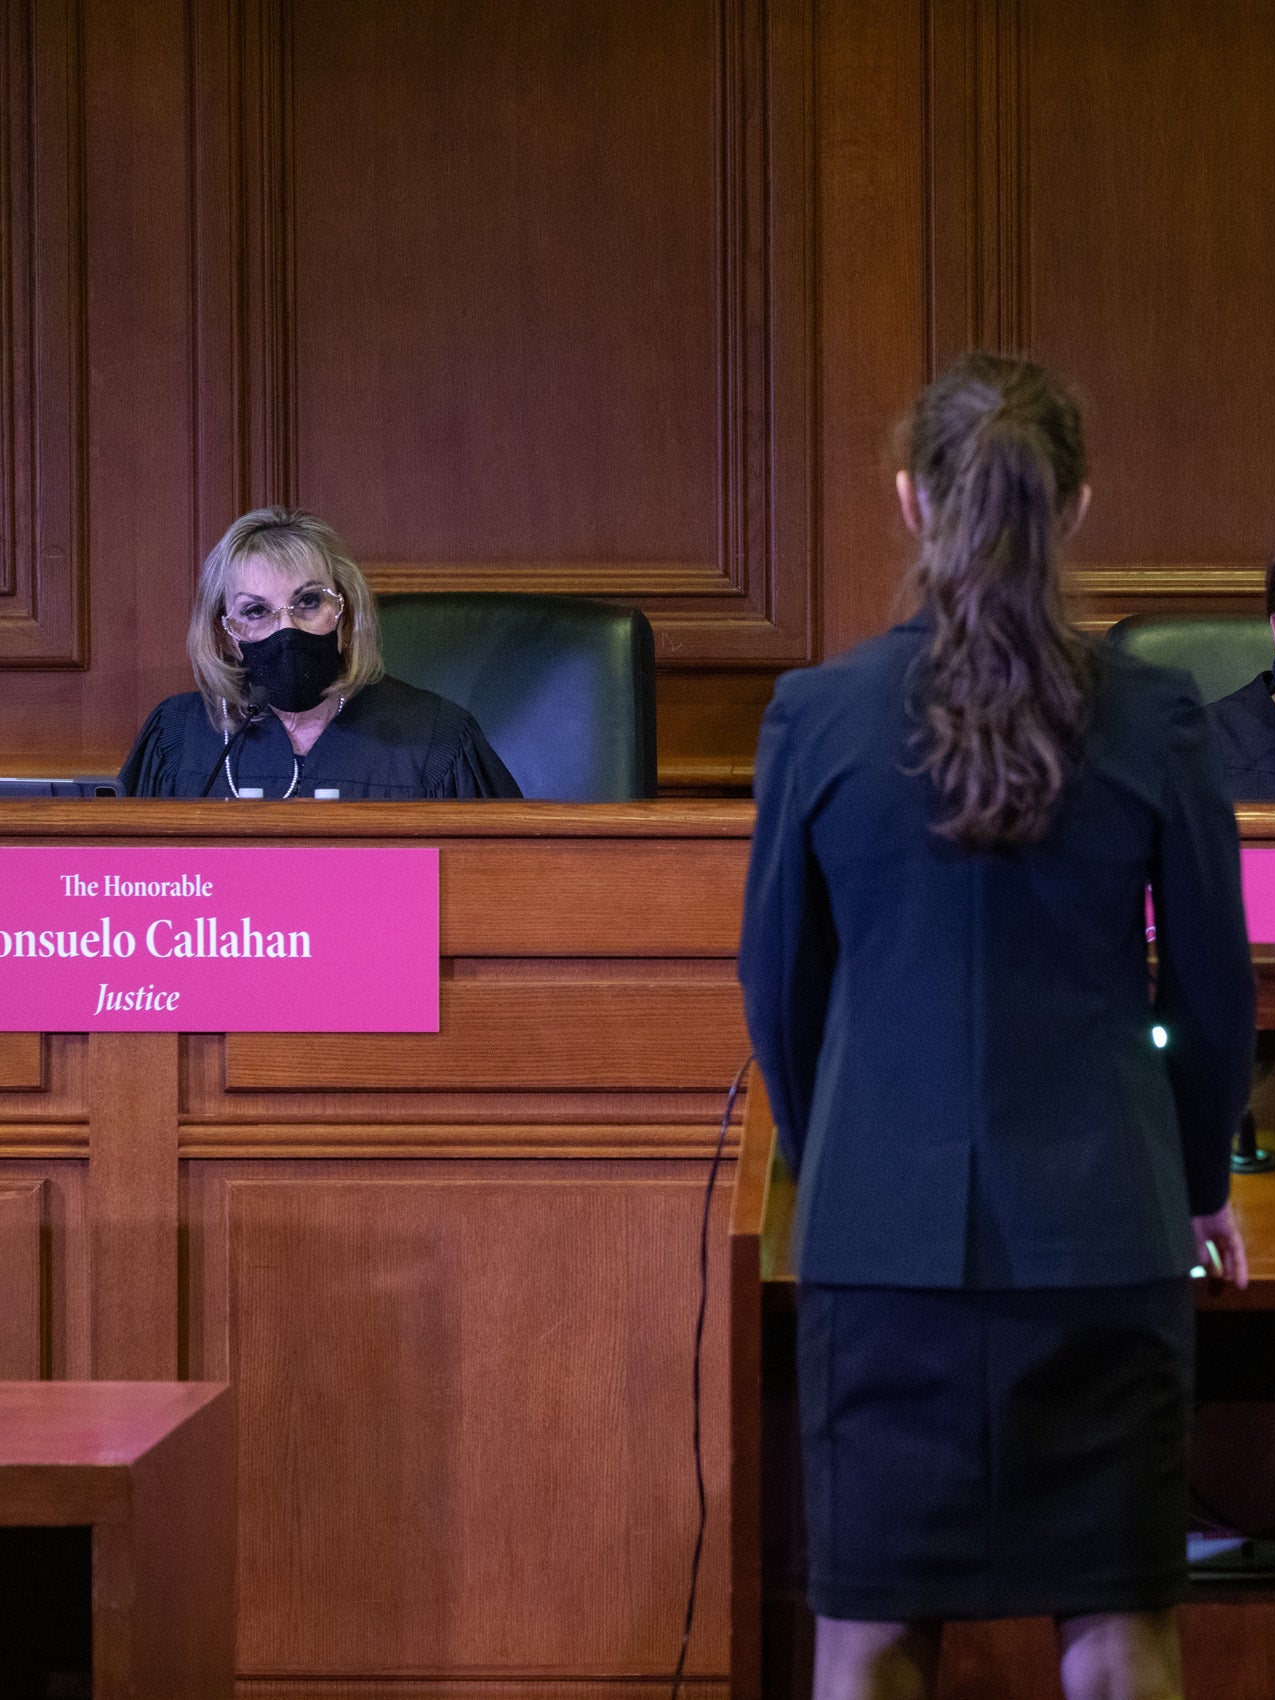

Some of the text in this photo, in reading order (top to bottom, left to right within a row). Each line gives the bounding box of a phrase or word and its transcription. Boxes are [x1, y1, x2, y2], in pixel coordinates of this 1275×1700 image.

[60, 873, 213, 897] The Honorable
[145, 916, 313, 959] Callahan
[93, 983, 181, 1016] Justice
